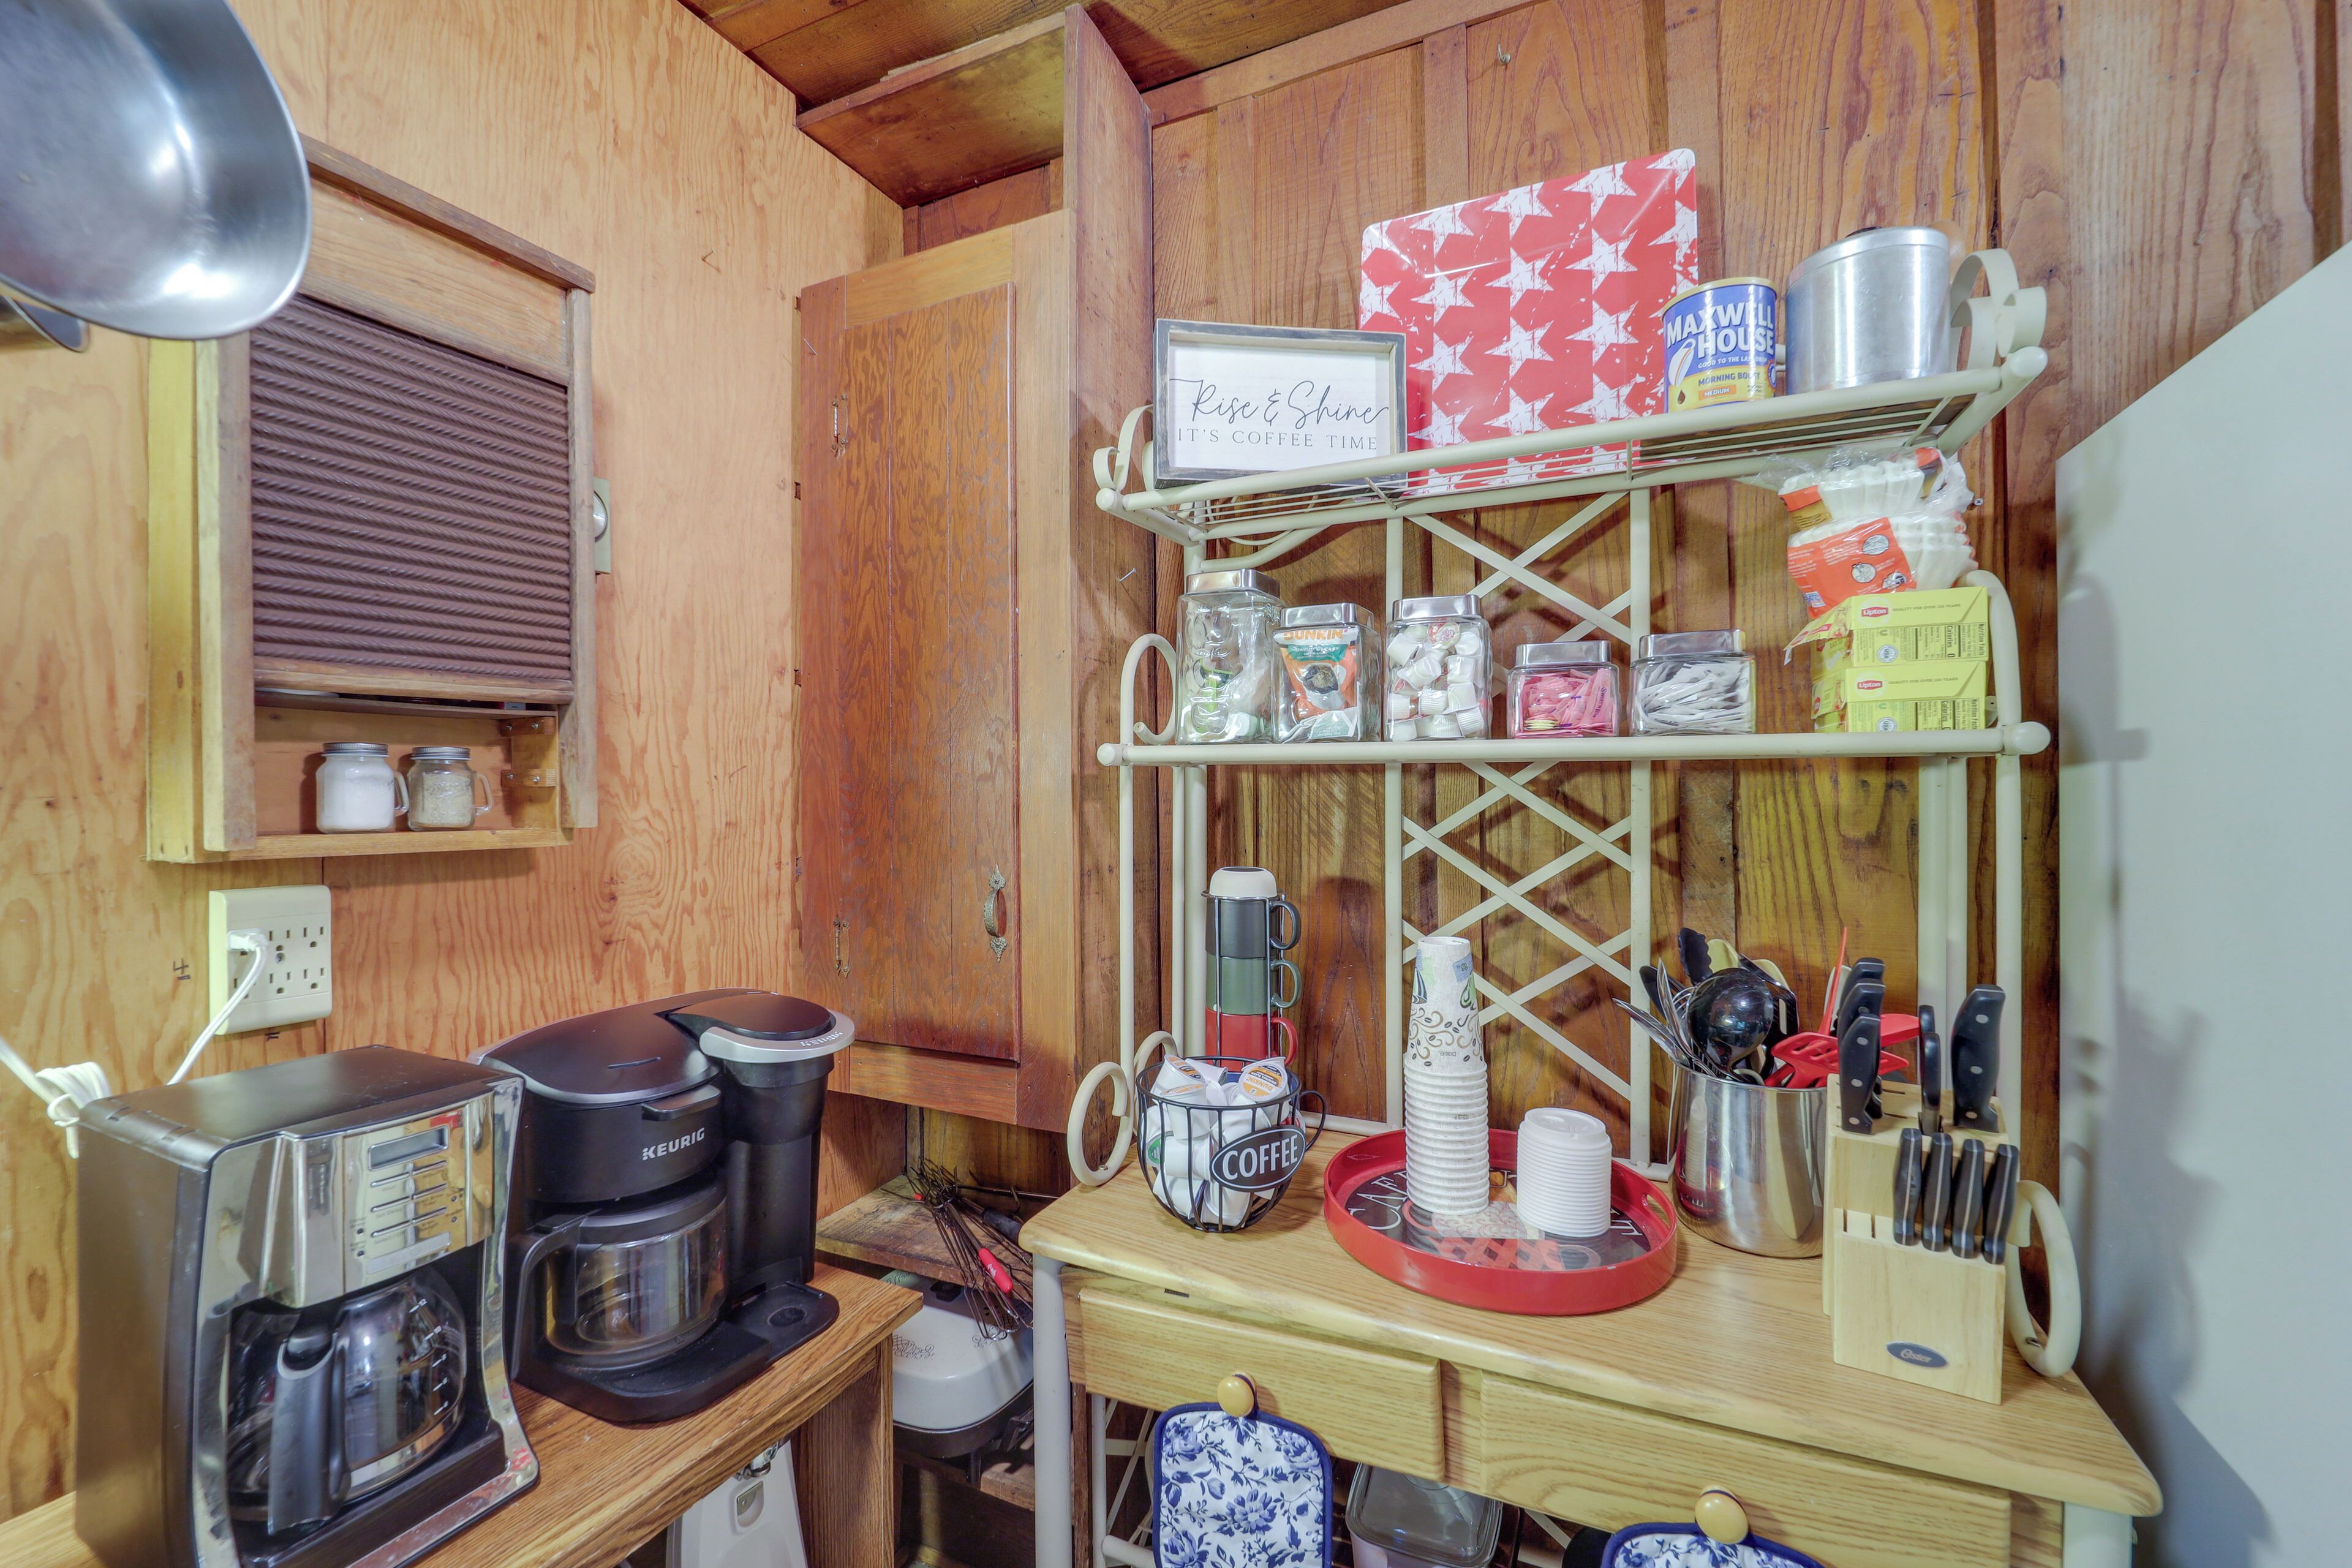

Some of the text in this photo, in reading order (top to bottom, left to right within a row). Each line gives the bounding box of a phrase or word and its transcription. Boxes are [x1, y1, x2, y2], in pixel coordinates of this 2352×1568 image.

[1667, 301, 1773, 349] MAXWELL
[1697, 326, 1774, 358] HOUSE
[1698, 360, 1716, 369] GOOD
[1698, 372, 1736, 386] MORNING
[1704, 387, 1730, 397] MEDIUM
[1170, 378, 1389, 430] Rise & Shine
[1178, 428, 1378, 450] IT'S COFFEE TIME
[1283, 629, 1348, 641] DUNKIN'
[800, 1031, 843, 1047] KEURIG
[1246, 1076, 1274, 1092] DUNKIN'
[642, 1127, 705, 1161] KEURIG
[1222, 1134, 1298, 1180] COFFEE
[1348, 1170, 1409, 1230] CAF
[1900, 1348, 1932, 1363] Oster
